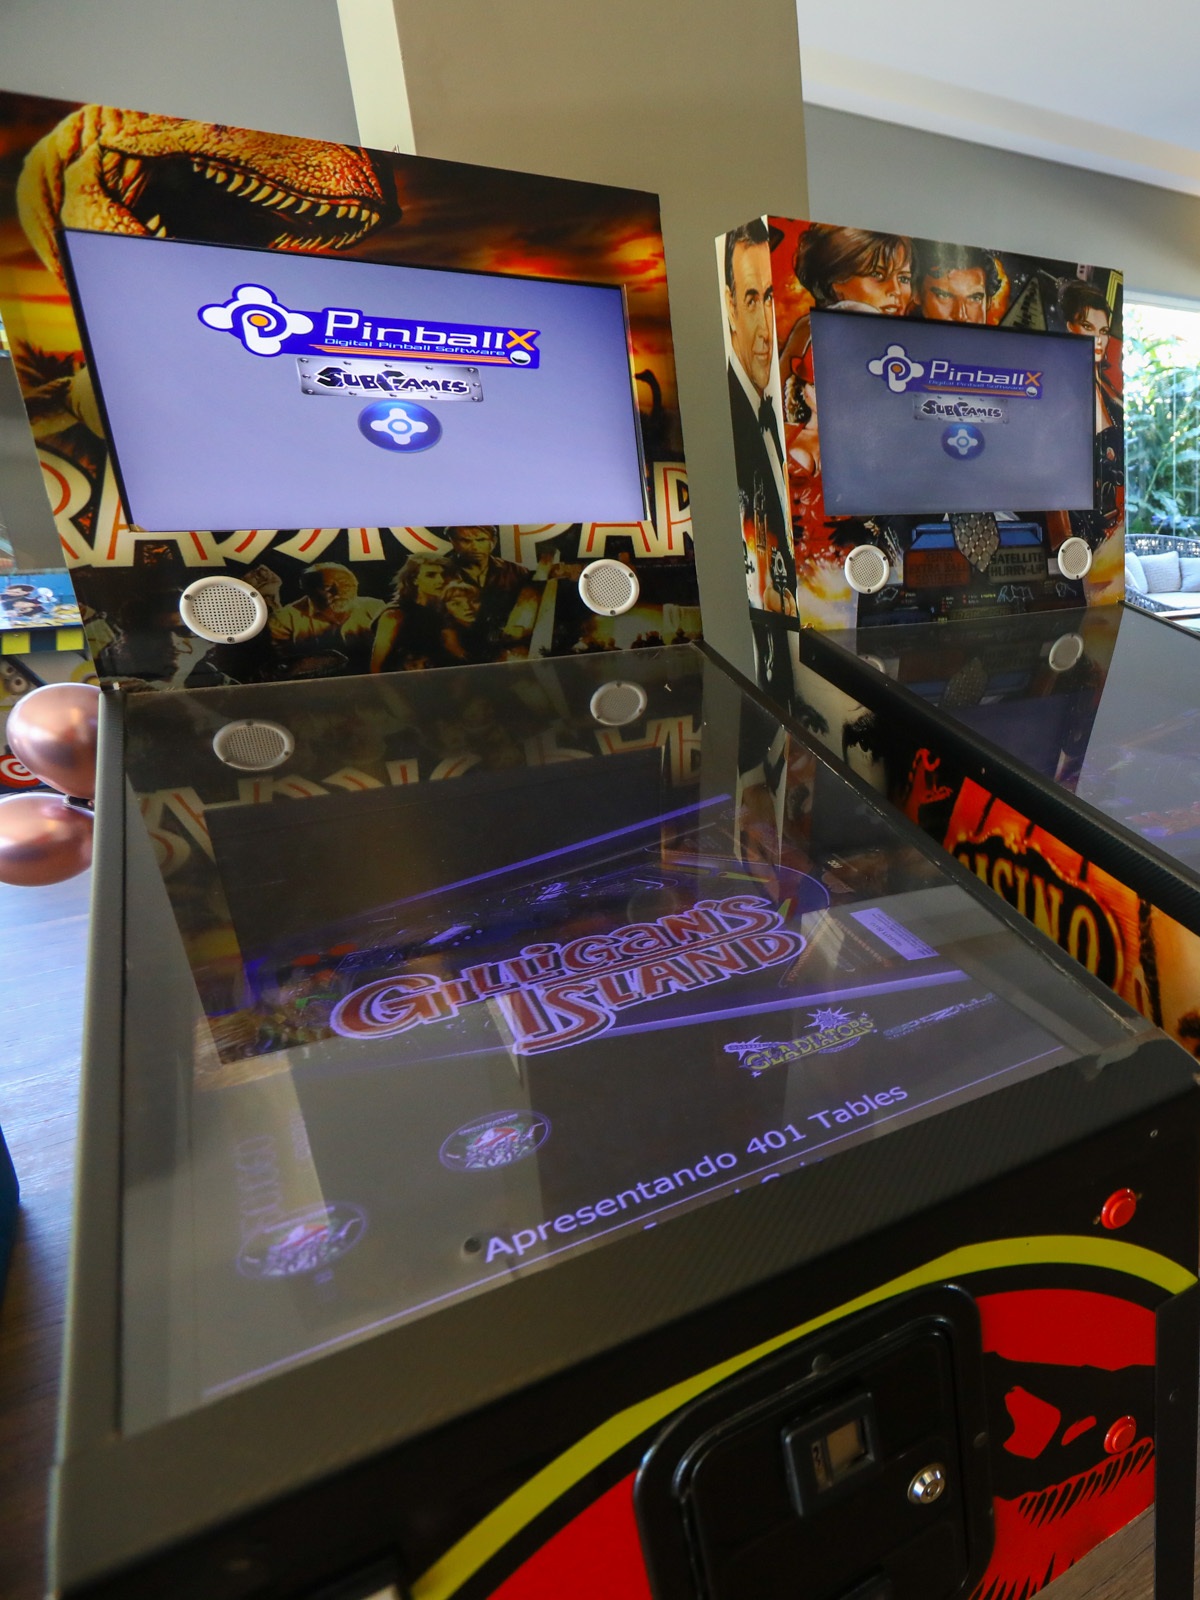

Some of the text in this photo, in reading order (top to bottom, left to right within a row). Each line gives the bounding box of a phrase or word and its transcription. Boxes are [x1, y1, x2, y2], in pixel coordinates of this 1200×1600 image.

[324, 309, 537, 351] PinballX
[324, 337, 506, 356] Digital Pinball Software
[929, 360, 1042, 387] PinballX
[990, 563, 1045, 577] HURRY-UP
[991, 552, 1044, 565] SATELLITE
[503, 930, 807, 1055] ISLAND
[745, 1016, 875, 1071] GLADIATORS
[485, 1150, 738, 1263] Apresentando
[746, 1123, 807, 1155] 401
[808, 1086, 909, 1130] Tables
